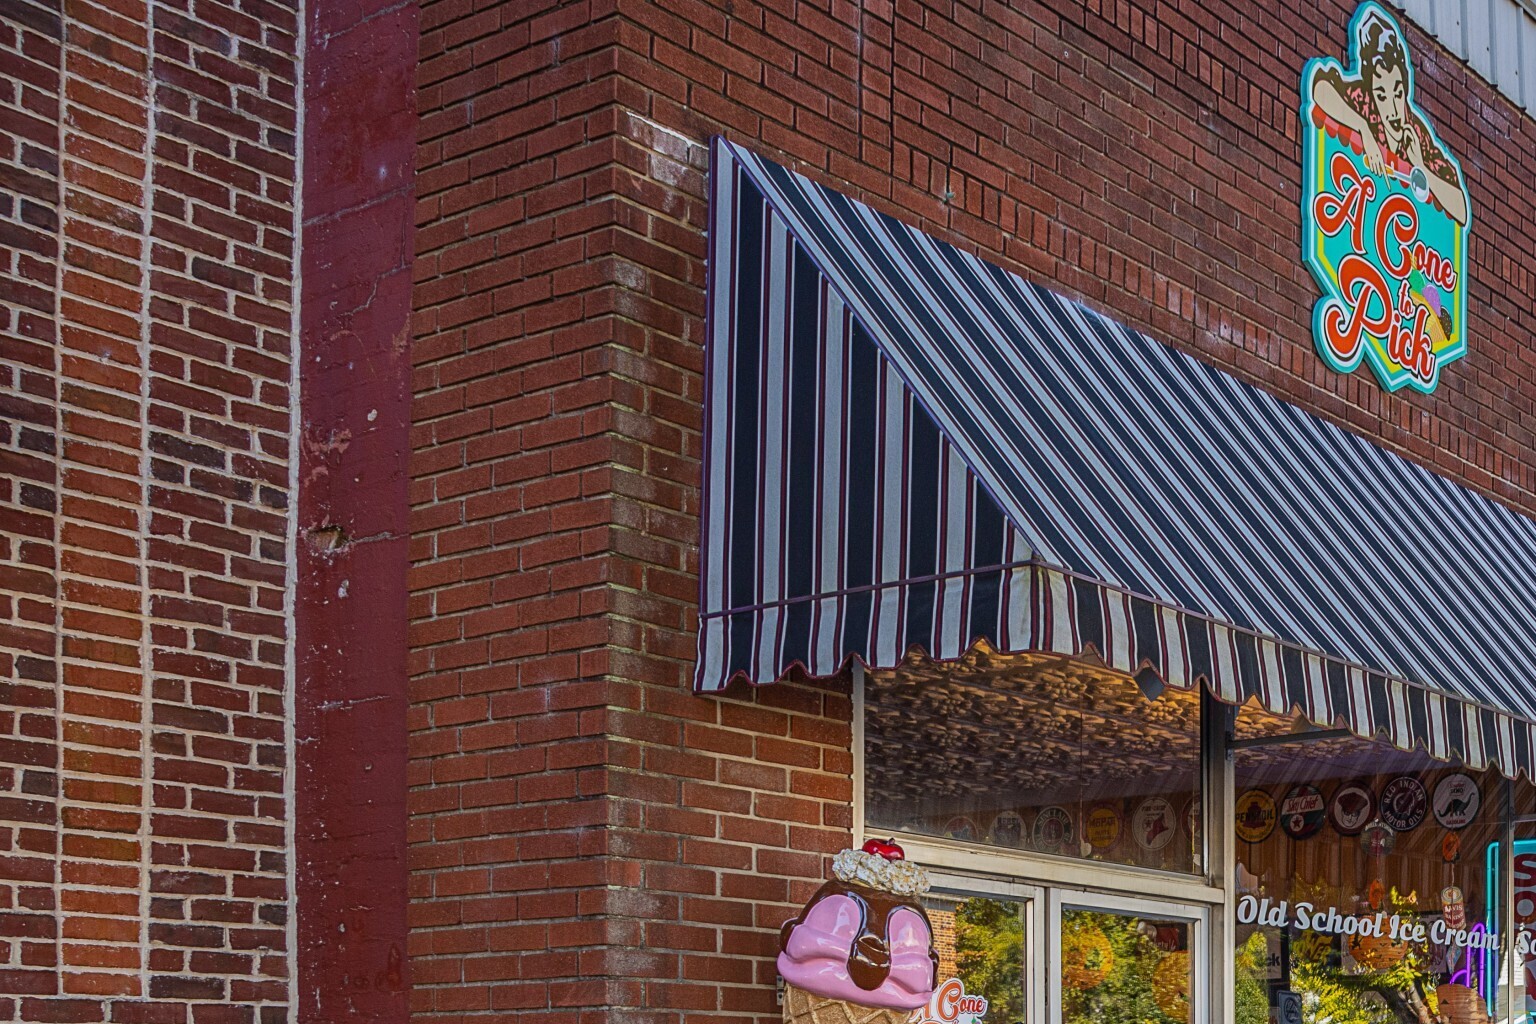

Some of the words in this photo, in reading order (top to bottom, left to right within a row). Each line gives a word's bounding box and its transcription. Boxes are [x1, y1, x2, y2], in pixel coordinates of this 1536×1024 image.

[1314, 153, 1376, 254] A
[1375, 194, 1457, 290] Cone
[1325, 255, 1434, 379] Pick
[1398, 283, 1413, 319] to
[1399, 780, 1425, 801] INDIAN
[1384, 810, 1406, 828] MOTOR
[1408, 809, 1423, 826] OILS
[1237, 895, 1289, 928] Old
[1294, 902, 1384, 938] School
[1389, 914, 1427, 943] Ice
[1430, 919, 1500, 951] Cream
[936, 980, 987, 1021] Cone
